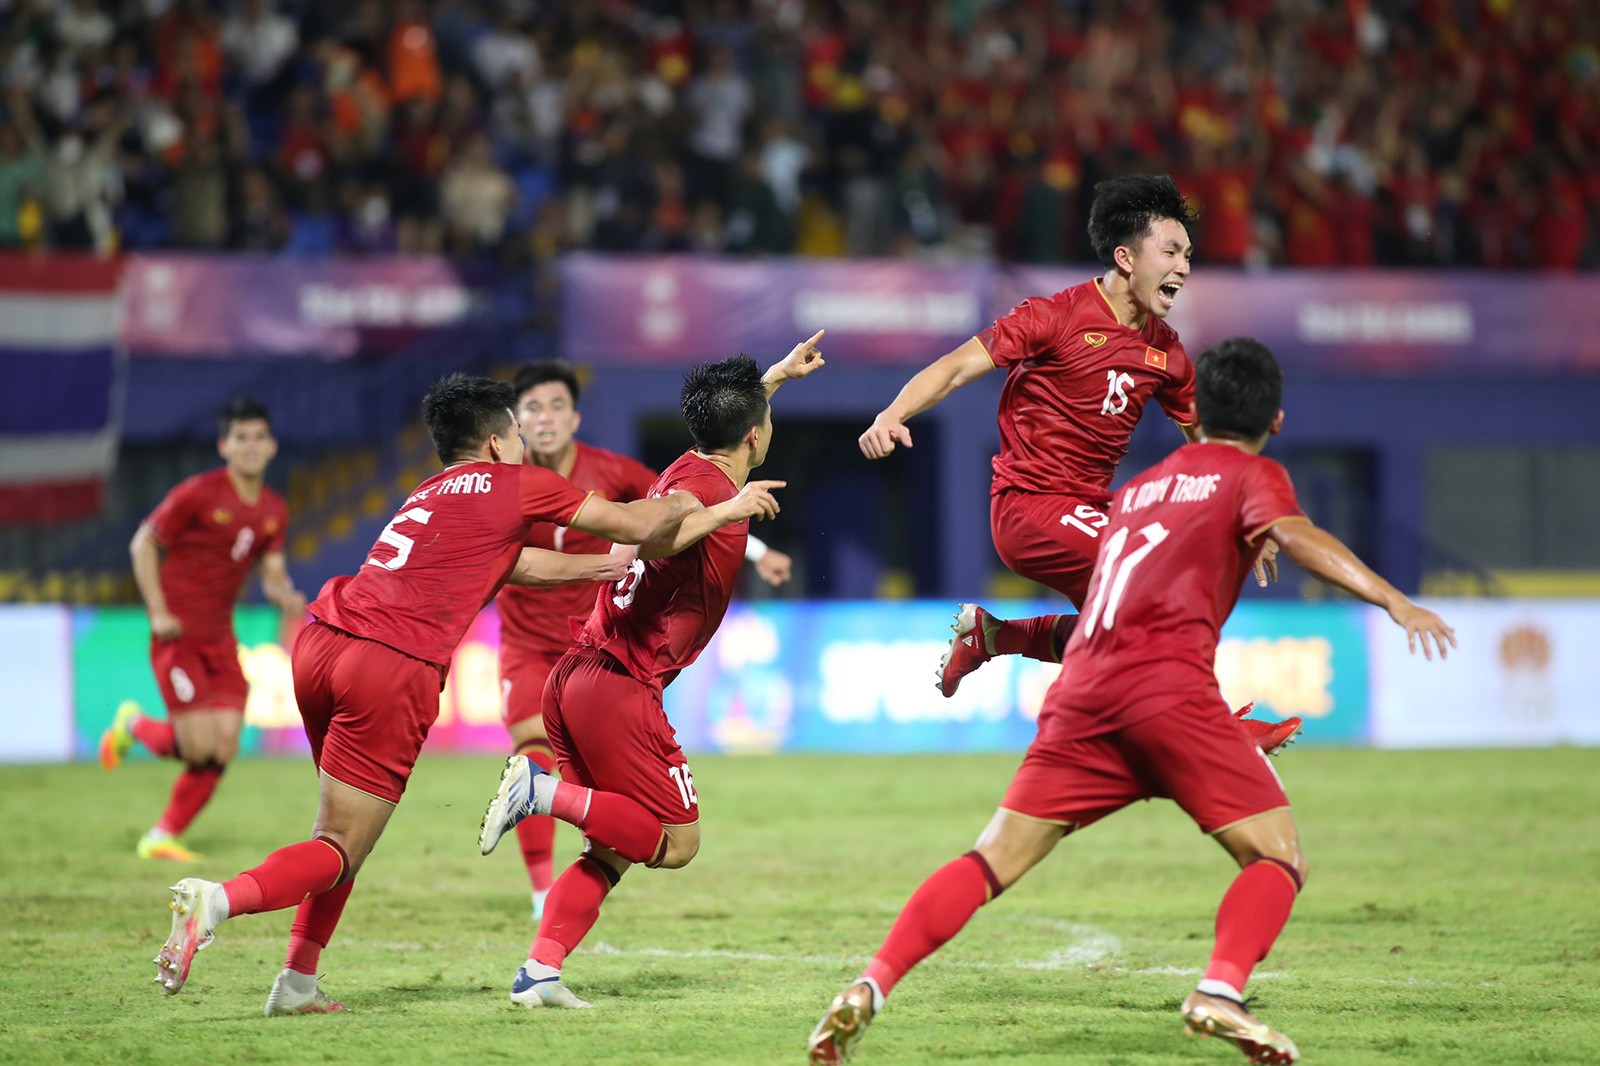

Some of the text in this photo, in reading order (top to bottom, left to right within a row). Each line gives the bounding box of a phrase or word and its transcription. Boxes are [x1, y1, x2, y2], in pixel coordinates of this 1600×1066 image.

[1100, 370, 1134, 415] 15
[367, 507, 433, 571] 5
[1060, 505, 1109, 538] 15
[1084, 522, 1169, 639] 17
